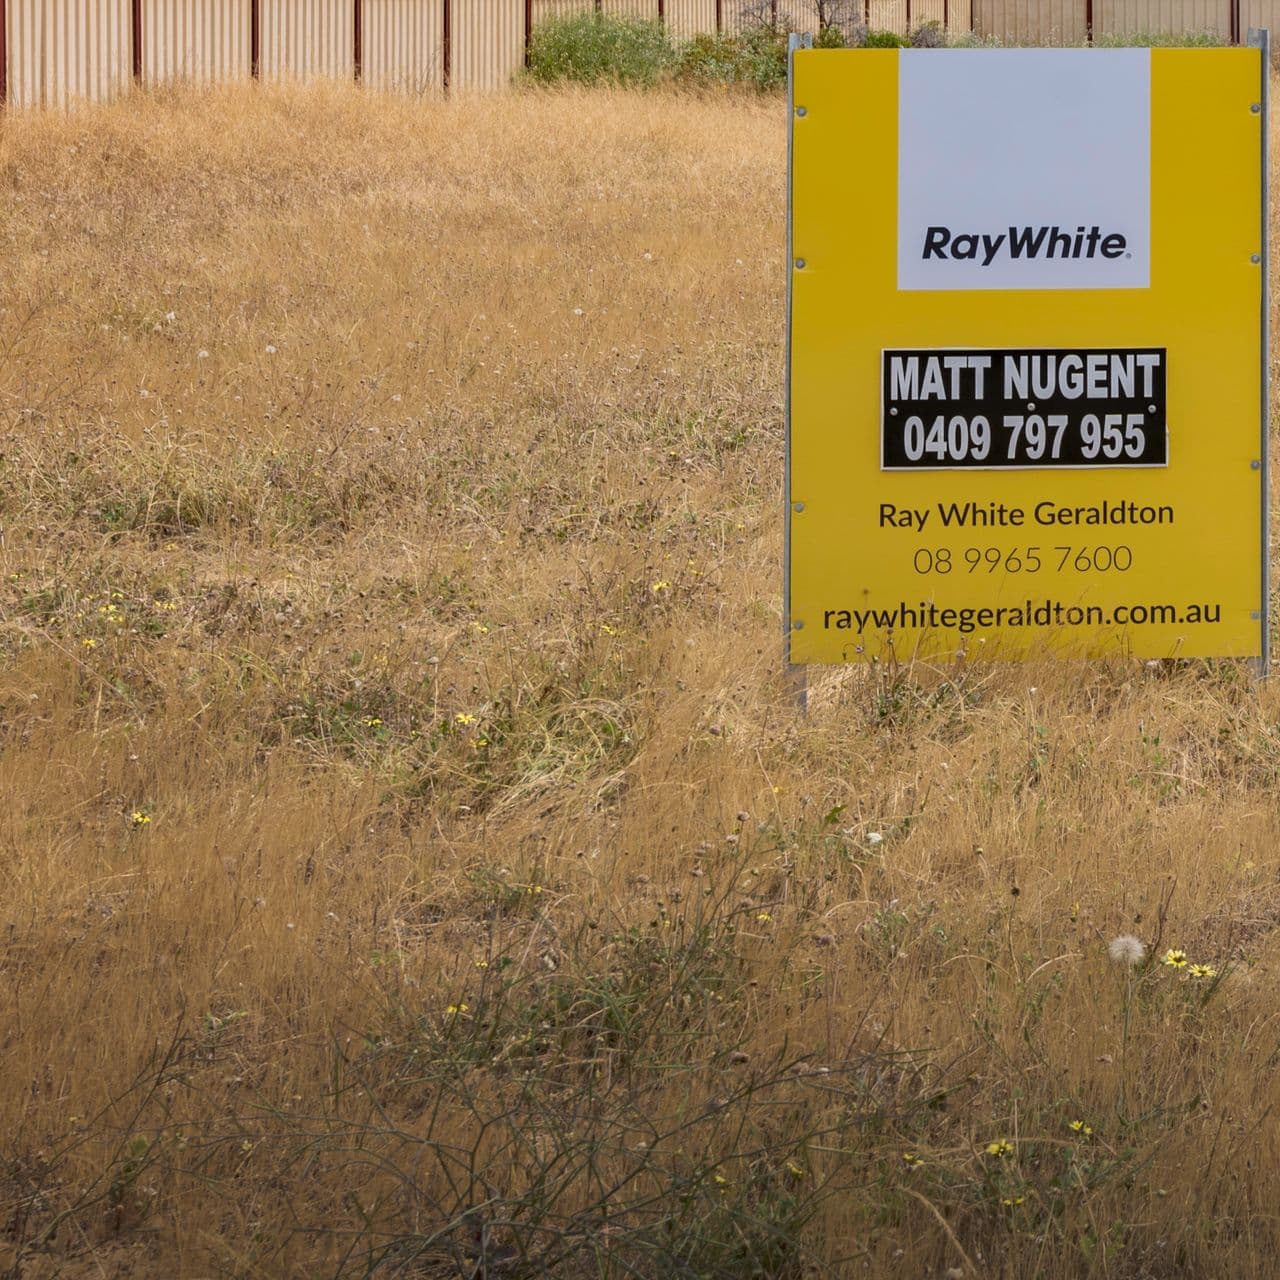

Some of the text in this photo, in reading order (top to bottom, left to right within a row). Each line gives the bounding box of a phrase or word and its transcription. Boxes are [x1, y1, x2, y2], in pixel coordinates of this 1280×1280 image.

[890, 354, 1160, 401] MATT NUGENT
[904, 414, 1145, 460] 0409 797 955
[879, 501, 1174, 532] Ray White Geraldton
[914, 546, 1132, 575] 08 9965 7600
[823, 601, 1221, 633] raywhitegeraldton.com.au
